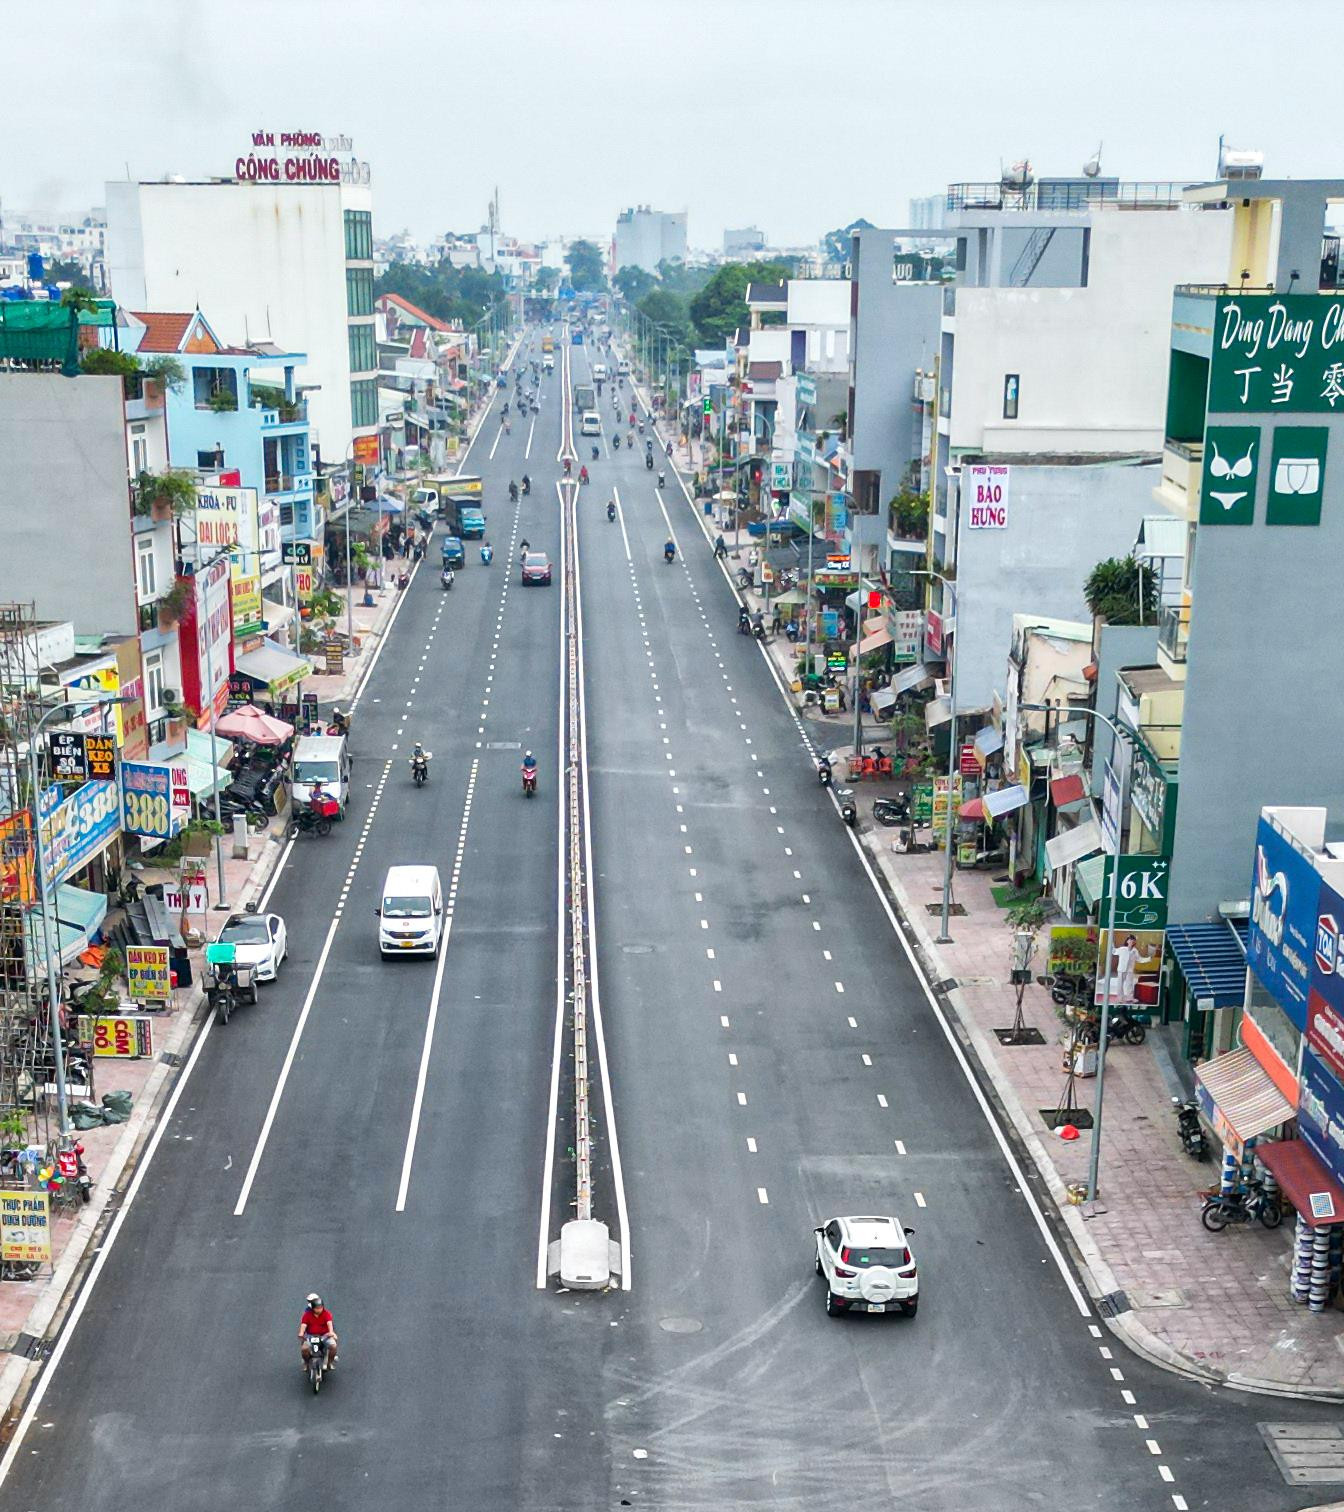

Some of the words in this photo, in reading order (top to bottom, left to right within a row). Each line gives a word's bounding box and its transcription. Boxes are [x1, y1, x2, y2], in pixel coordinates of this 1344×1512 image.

[236, 153, 279, 180] CÔNG
[285, 152, 340, 180] CHỨNG
[1267, 301, 1313, 358] Dang
[1234, 364, 1294, 404] 丁当
[88, 751, 113, 762] KEO
[93, 762, 110, 773] XE
[126, 792, 169, 834] 388
[1106, 871, 1166, 899] 16K
[1317, 930, 1334, 963] TOA
